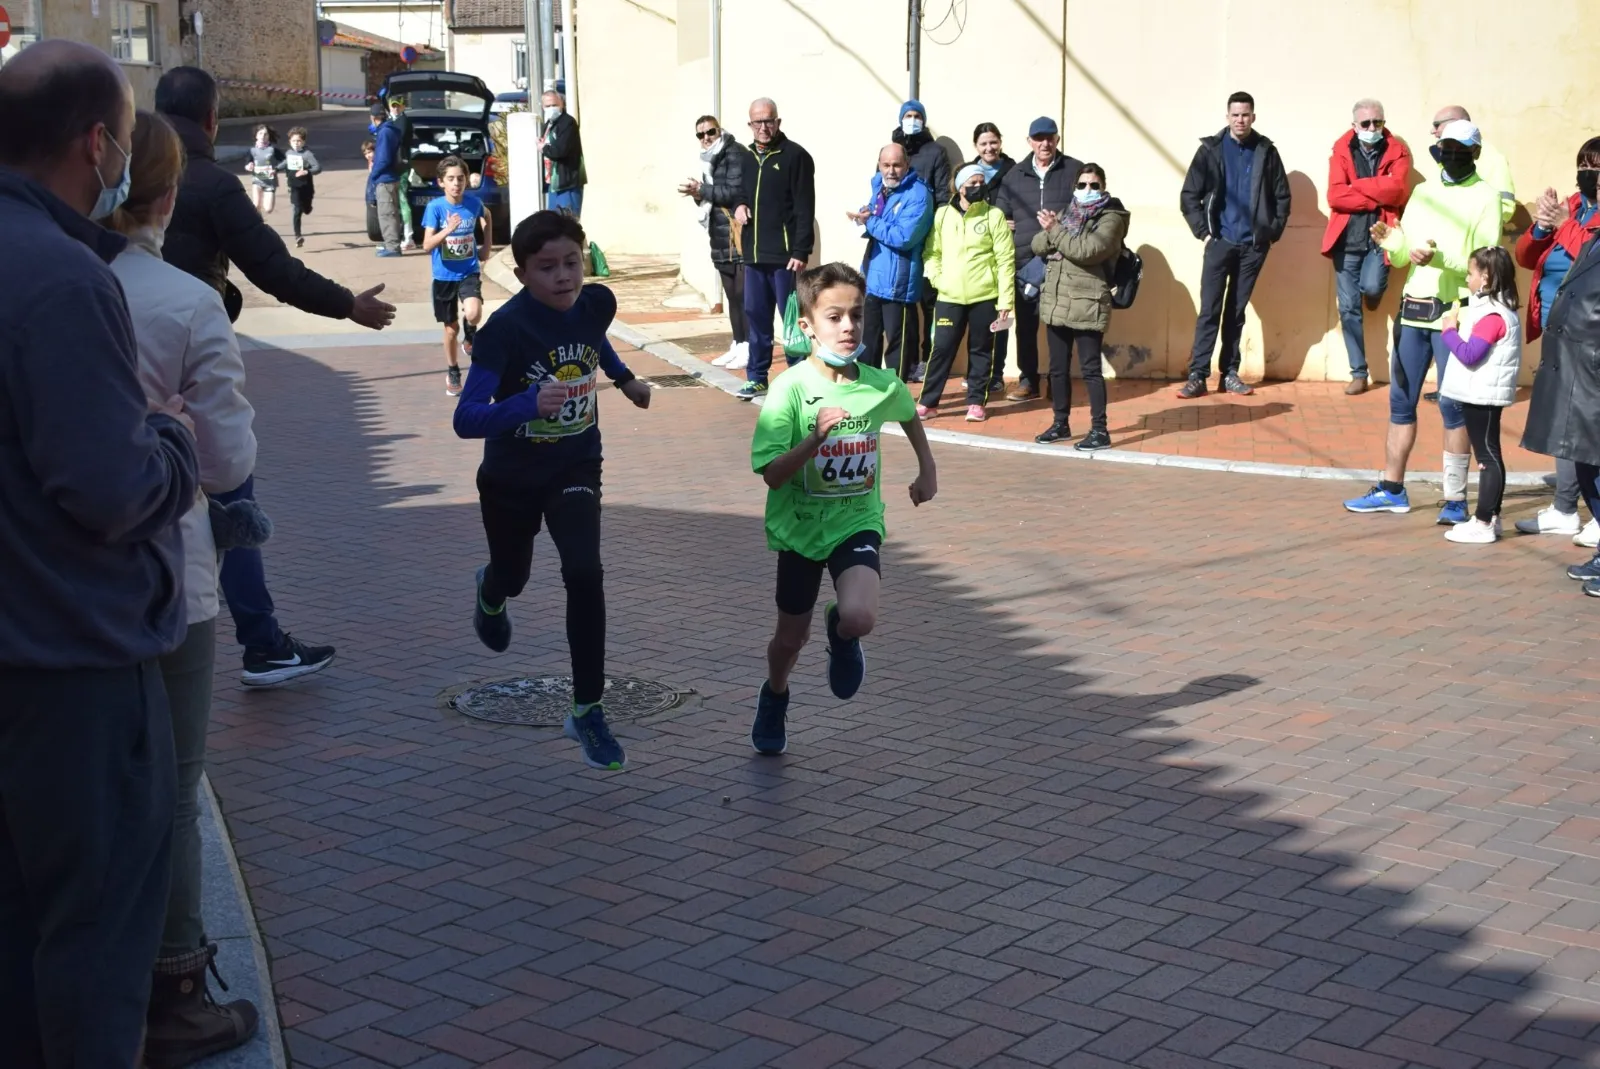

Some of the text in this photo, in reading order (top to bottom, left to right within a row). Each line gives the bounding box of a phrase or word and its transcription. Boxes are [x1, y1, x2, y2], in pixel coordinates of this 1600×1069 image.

[449, 244, 469, 254] 649
[520, 343, 599, 384] AN FRANCIS
[822, 455, 868, 481] 644
